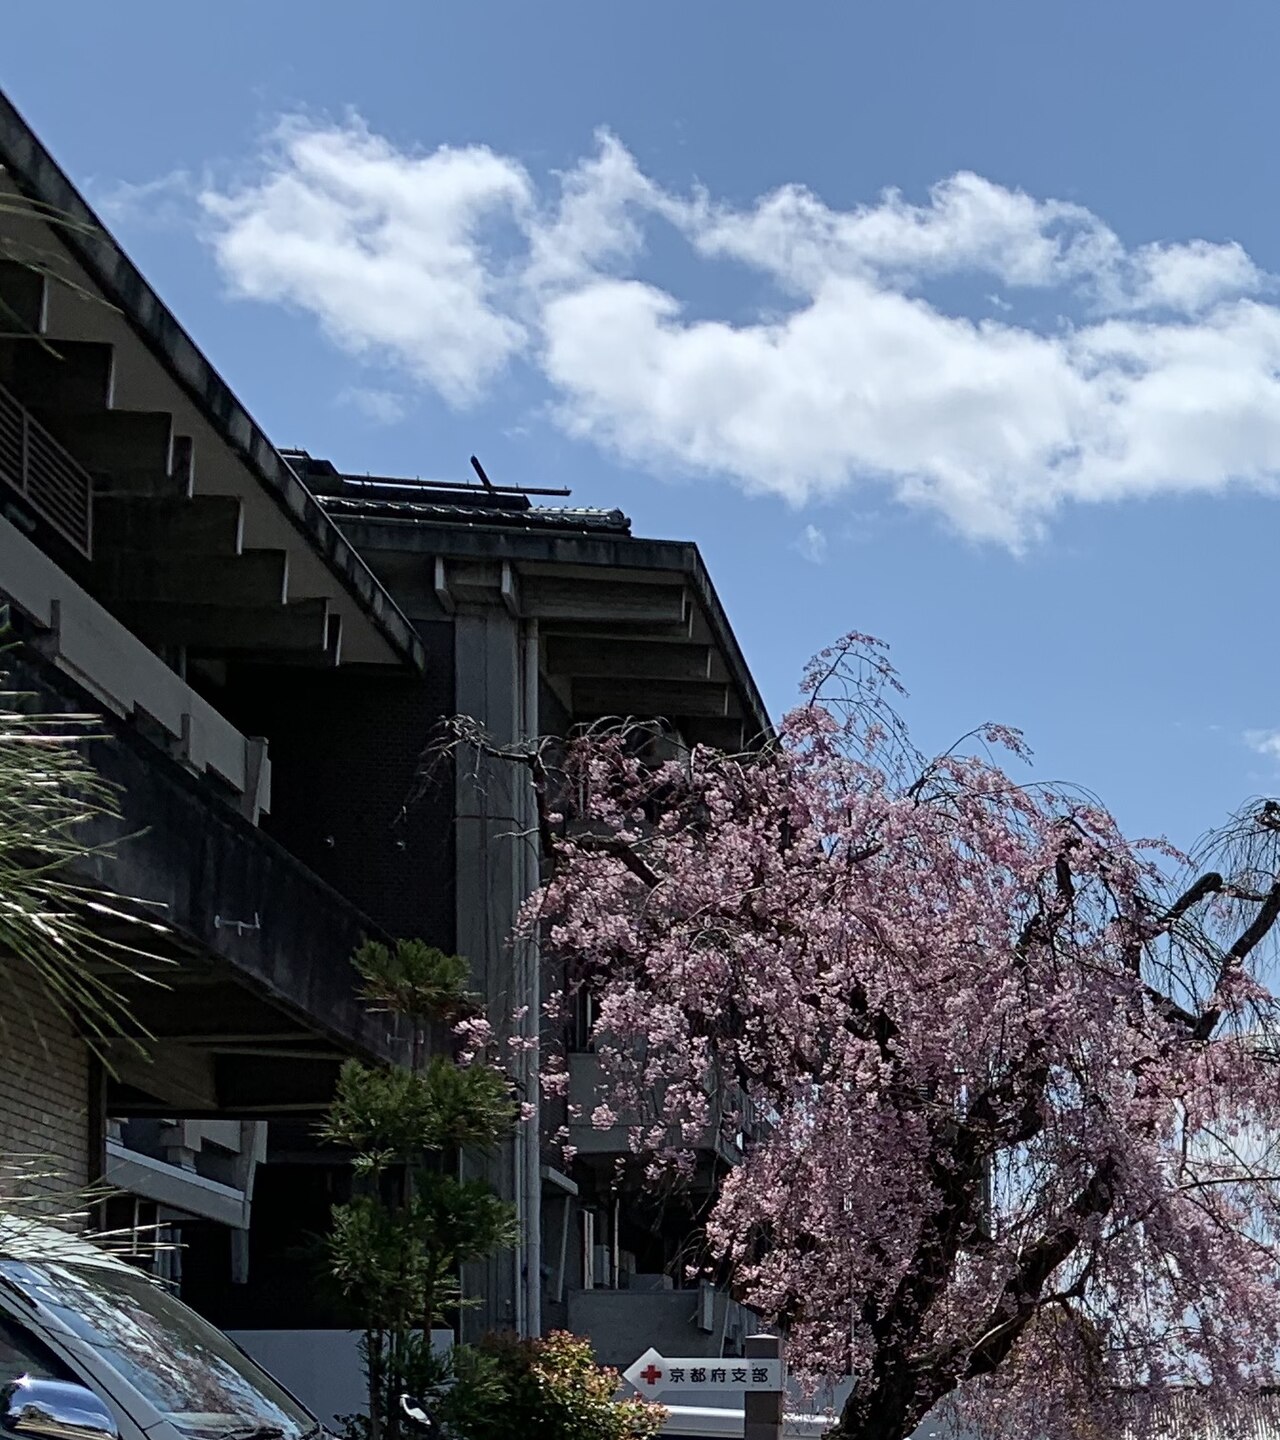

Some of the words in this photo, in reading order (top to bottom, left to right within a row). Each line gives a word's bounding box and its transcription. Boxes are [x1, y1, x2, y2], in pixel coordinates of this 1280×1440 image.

[669, 1367, 769, 1383] 京都府支部
